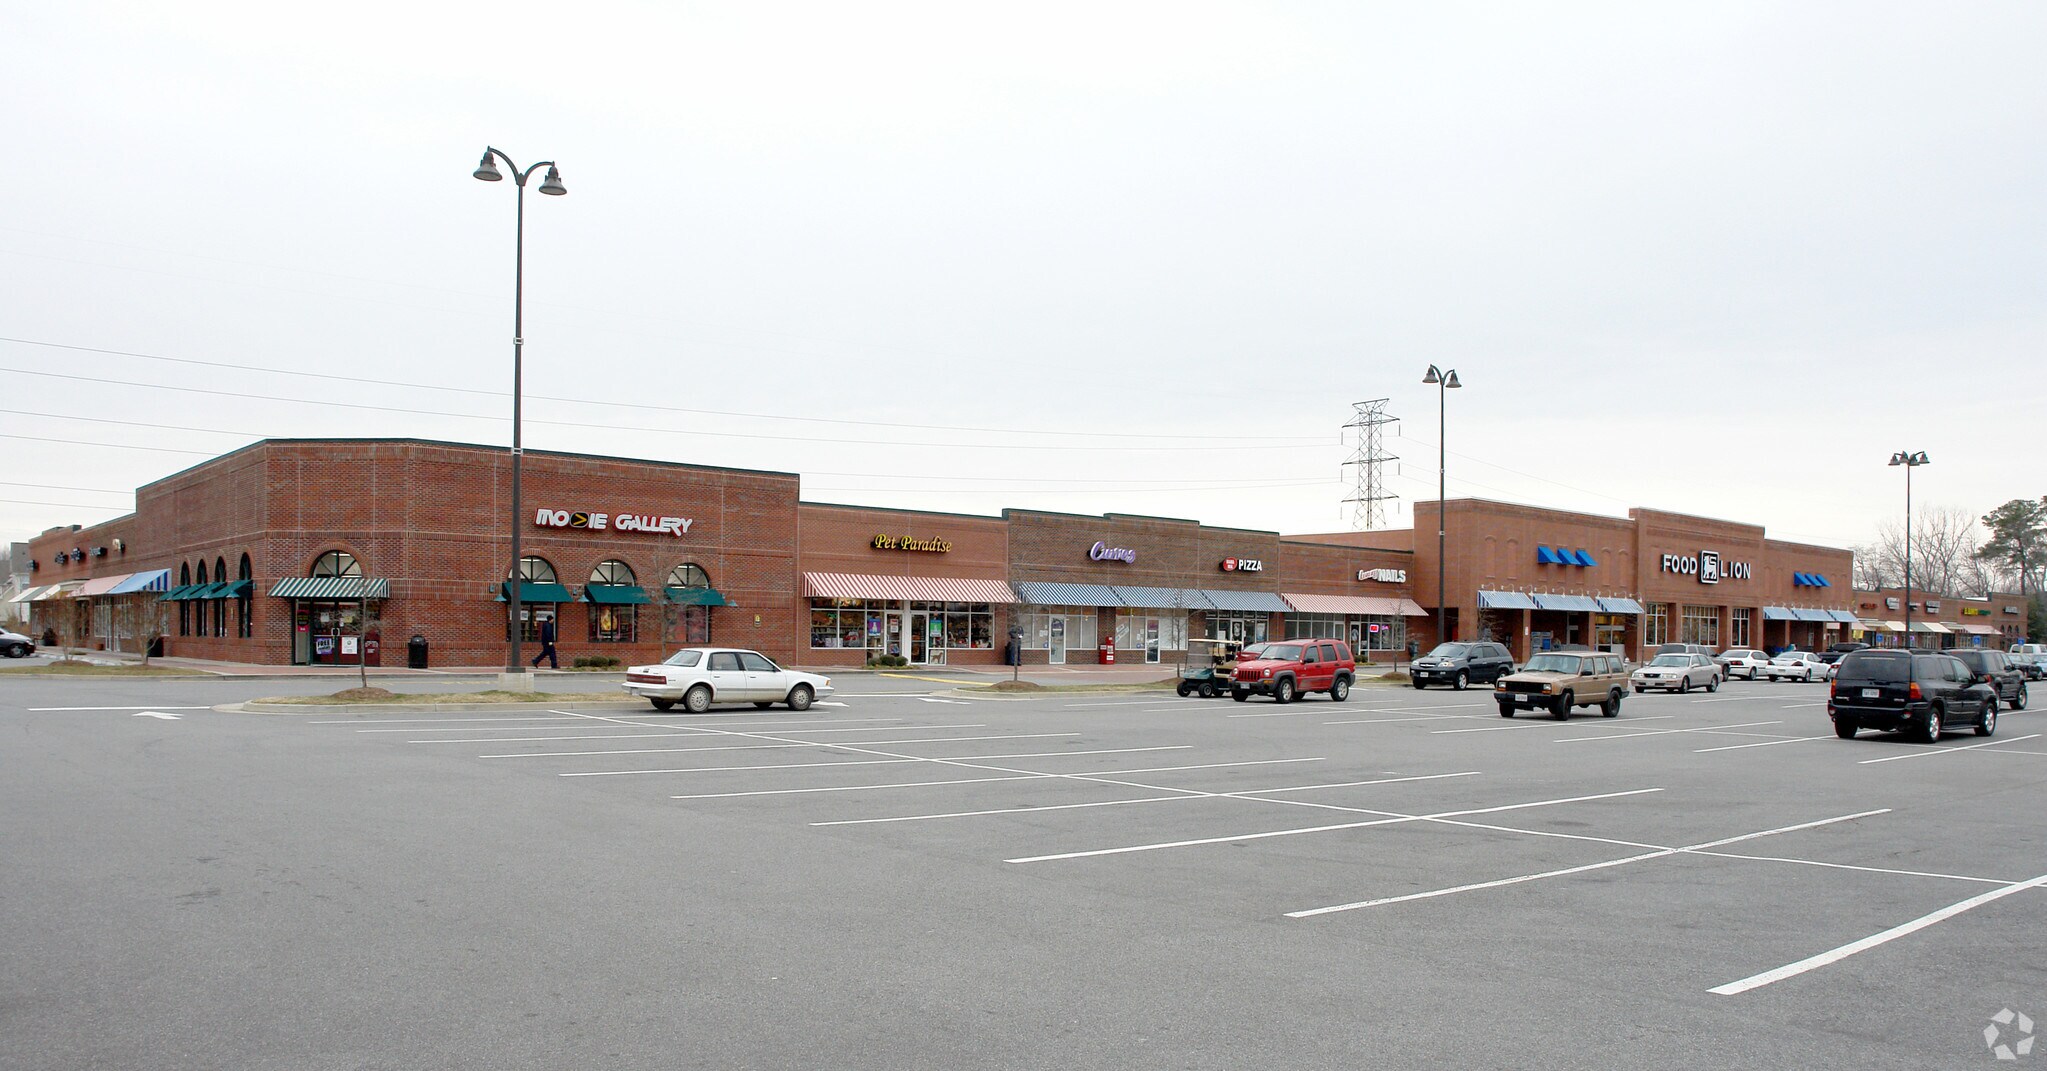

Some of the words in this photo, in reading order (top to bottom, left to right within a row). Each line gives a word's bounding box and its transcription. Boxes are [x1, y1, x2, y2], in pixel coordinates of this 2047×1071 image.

[614, 513, 693, 537] GALLERY
[874, 533, 897, 549] Pet
[900, 535, 952, 553] Paradise
[1238, 559, 1263, 571] PIZZA
[1662, 554, 1698, 575] FOOD
[1720, 560, 1751, 580] LION
[1377, 568, 1406, 583] NAILS
